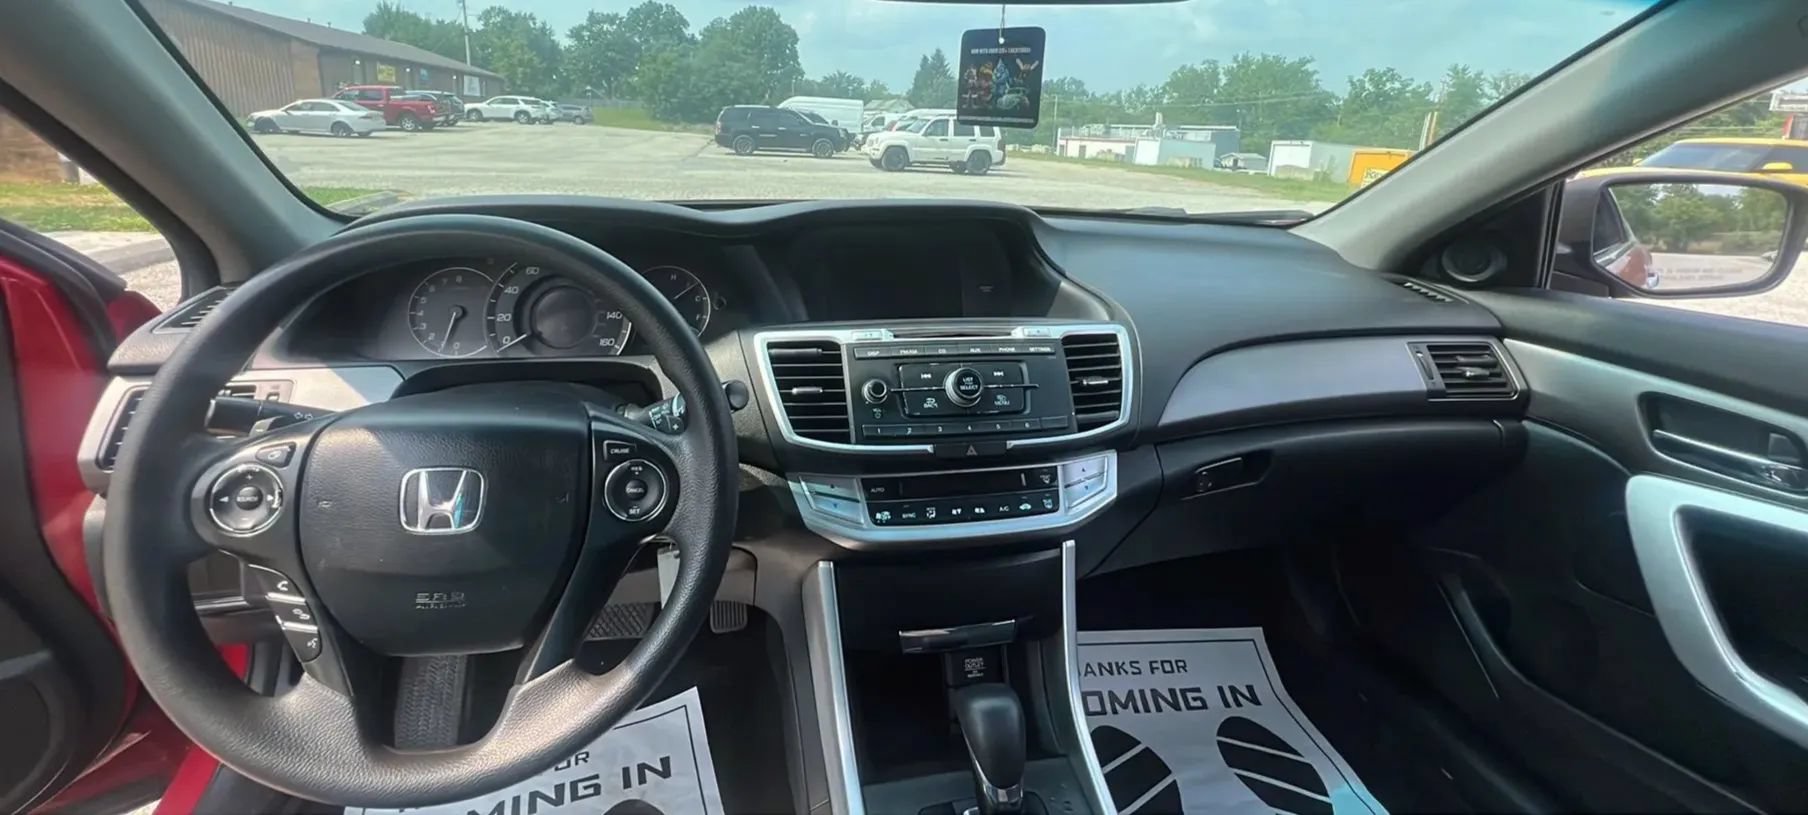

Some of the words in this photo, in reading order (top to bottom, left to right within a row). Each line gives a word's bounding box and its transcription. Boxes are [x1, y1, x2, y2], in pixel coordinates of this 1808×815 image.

[525, 266, 540, 275] 60
[504, 285, 519, 294] 40
[496, 313, 512, 322] 20
[606, 311, 623, 320] 140
[427, 332, 436, 341] 2
[502, 336, 511, 345] 0
[452, 341, 461, 350] 0
[599, 337, 615, 346] 160
[1079, 661, 1142, 677] ANKS
[1149, 659, 1188, 674] FOR
[1081, 687, 1208, 716] OMING
[1217, 684, 1262, 708] IN
[622, 755, 672, 789] IN
